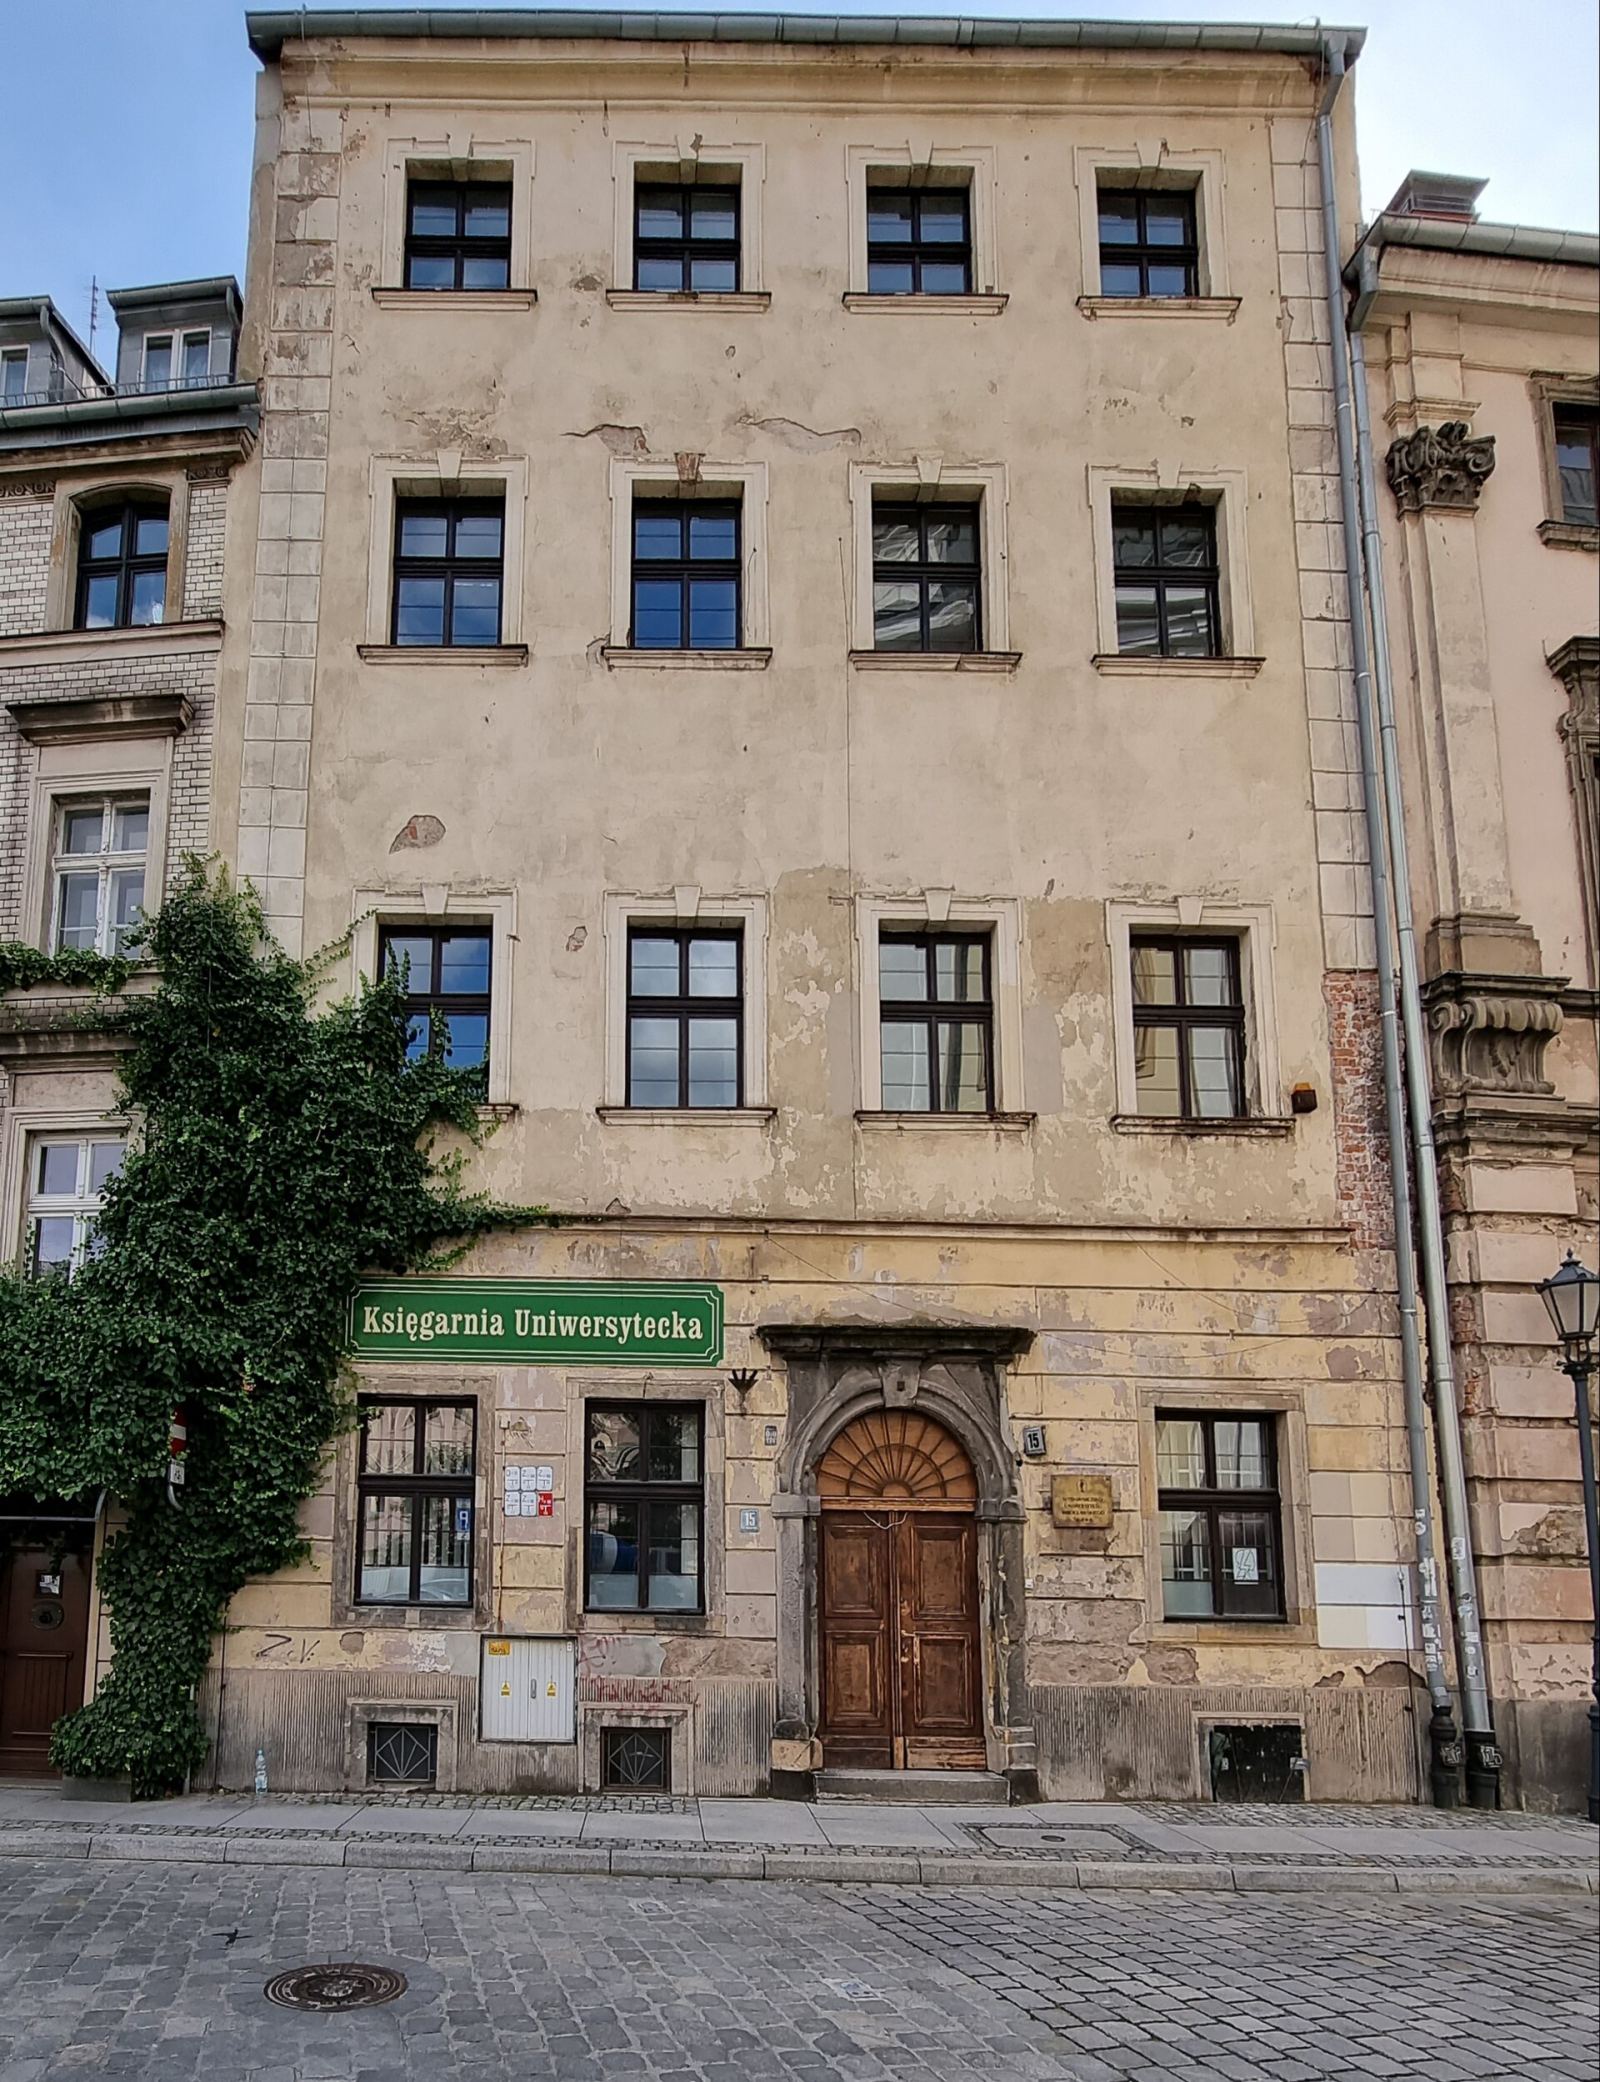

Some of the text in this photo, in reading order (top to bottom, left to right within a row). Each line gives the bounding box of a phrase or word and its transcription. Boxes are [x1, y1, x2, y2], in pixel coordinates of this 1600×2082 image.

[363, 1306, 704, 1345] Księgarnia Uniwersytecka
[1027, 1432, 1040, 1449] 15
[745, 1512, 755, 1526] 15
